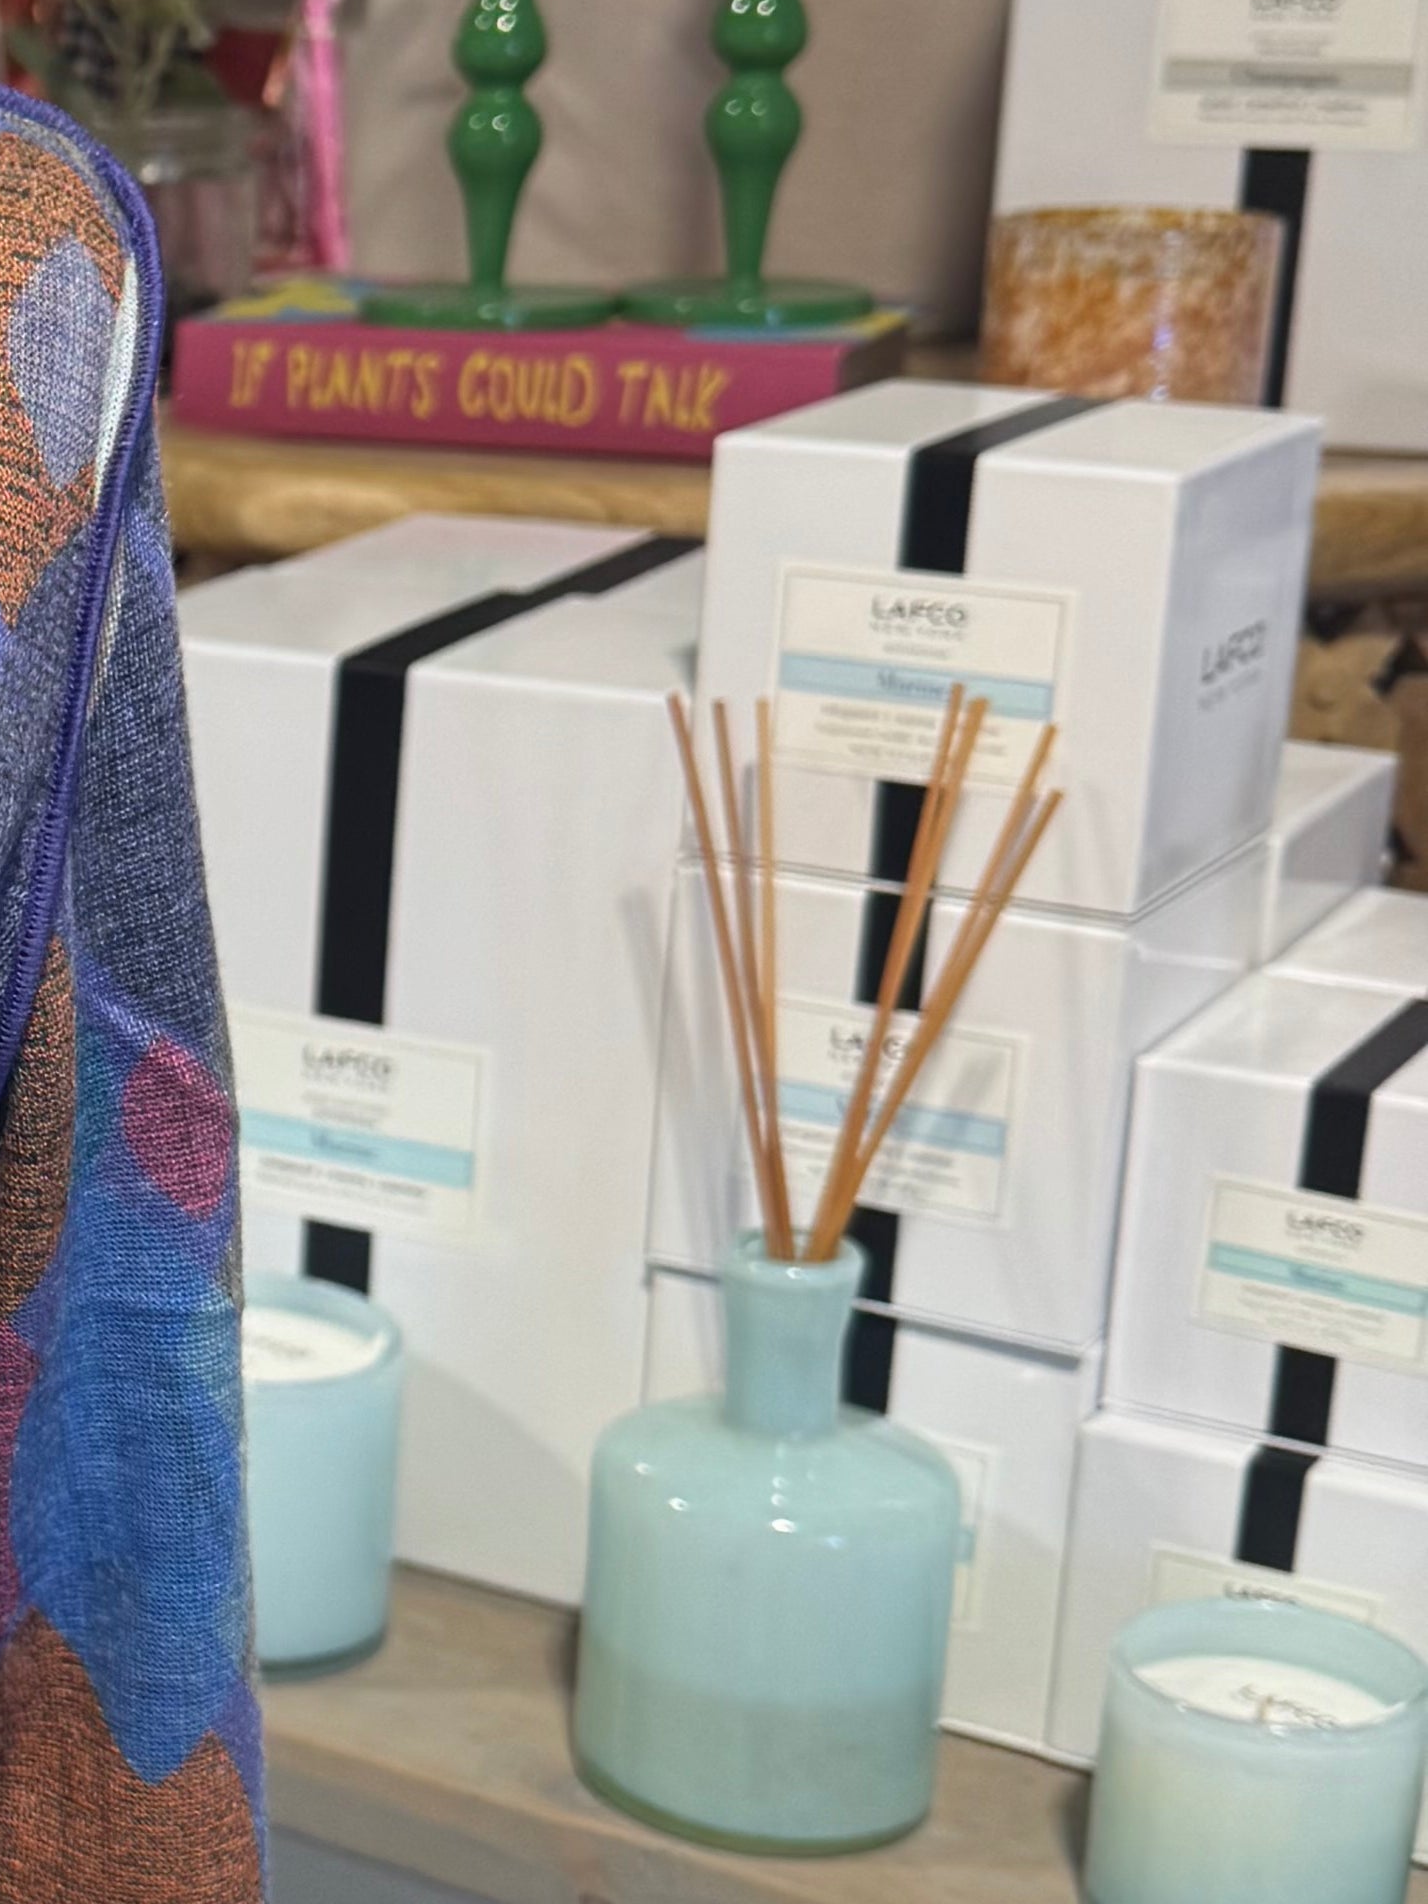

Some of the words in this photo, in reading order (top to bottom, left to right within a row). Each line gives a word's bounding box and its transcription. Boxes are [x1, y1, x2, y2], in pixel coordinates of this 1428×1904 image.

[229, 341, 274, 409] IF
[287, 343, 441, 420] PLANTS
[458, 349, 596, 428] COULD
[616, 360, 729, 433] TALK
[871, 595, 969, 629] LAFCO
